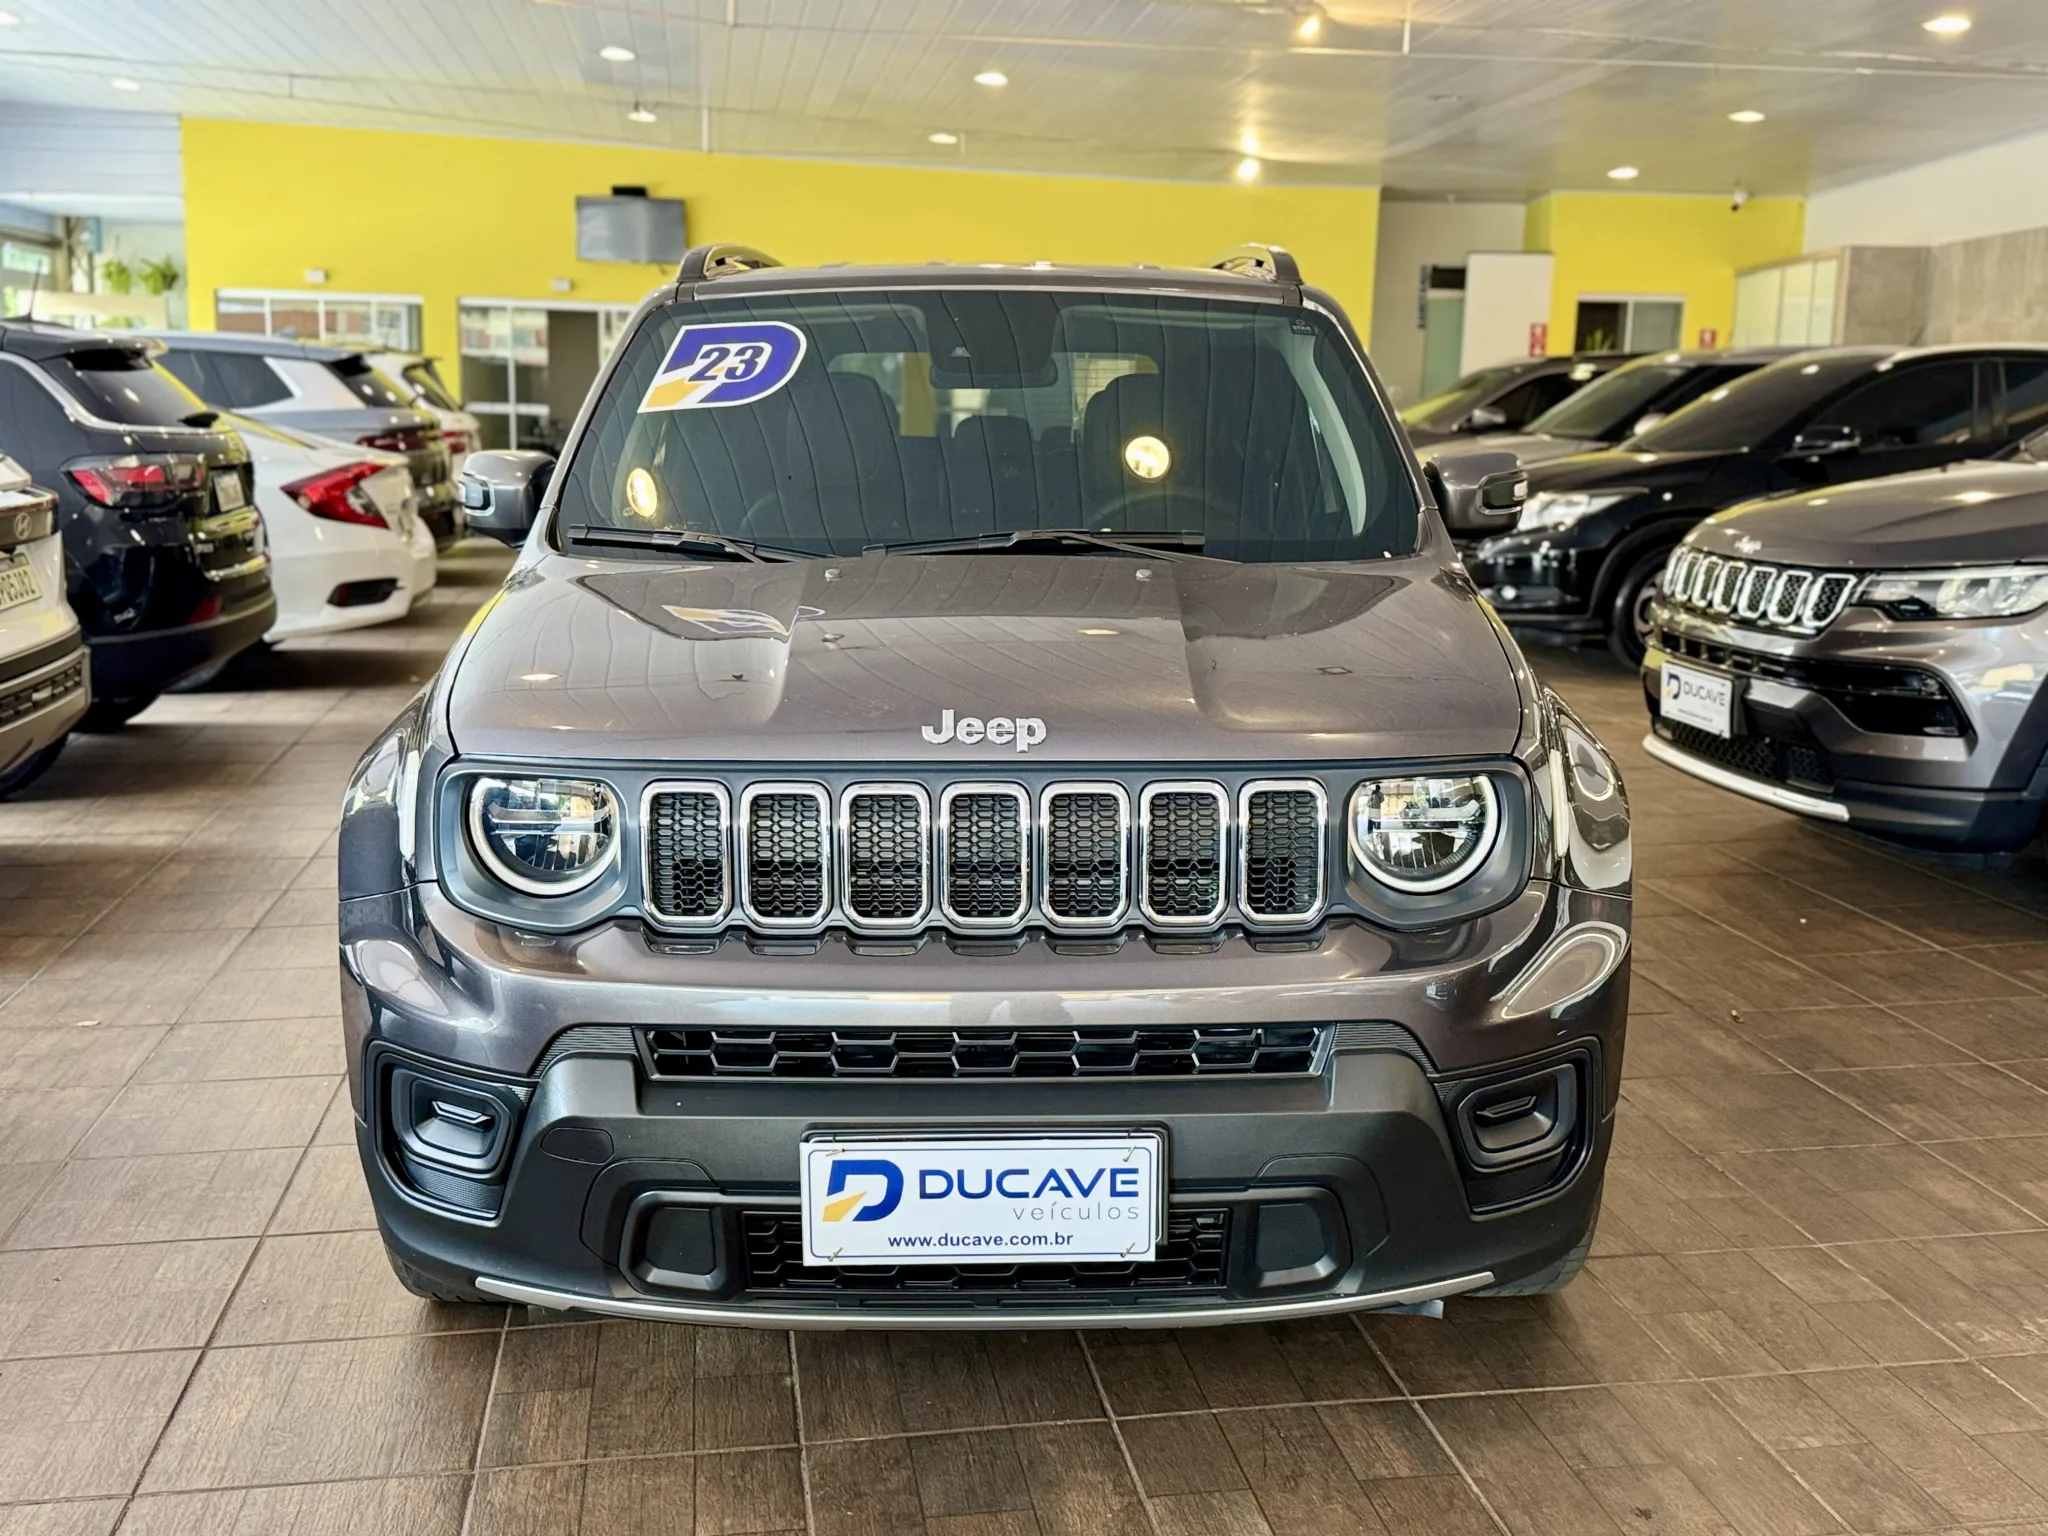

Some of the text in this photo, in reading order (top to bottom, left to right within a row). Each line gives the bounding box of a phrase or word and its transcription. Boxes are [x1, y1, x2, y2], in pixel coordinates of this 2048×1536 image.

[688, 345, 765, 383] 23
[1683, 681, 1726, 707] DUCAVE
[921, 708, 1047, 753] Jeep
[918, 1167, 1140, 1200] DUCAVE
[1012, 1202, 1140, 1221] veículos
[888, 1231, 1074, 1248] www.ducave.com.br
